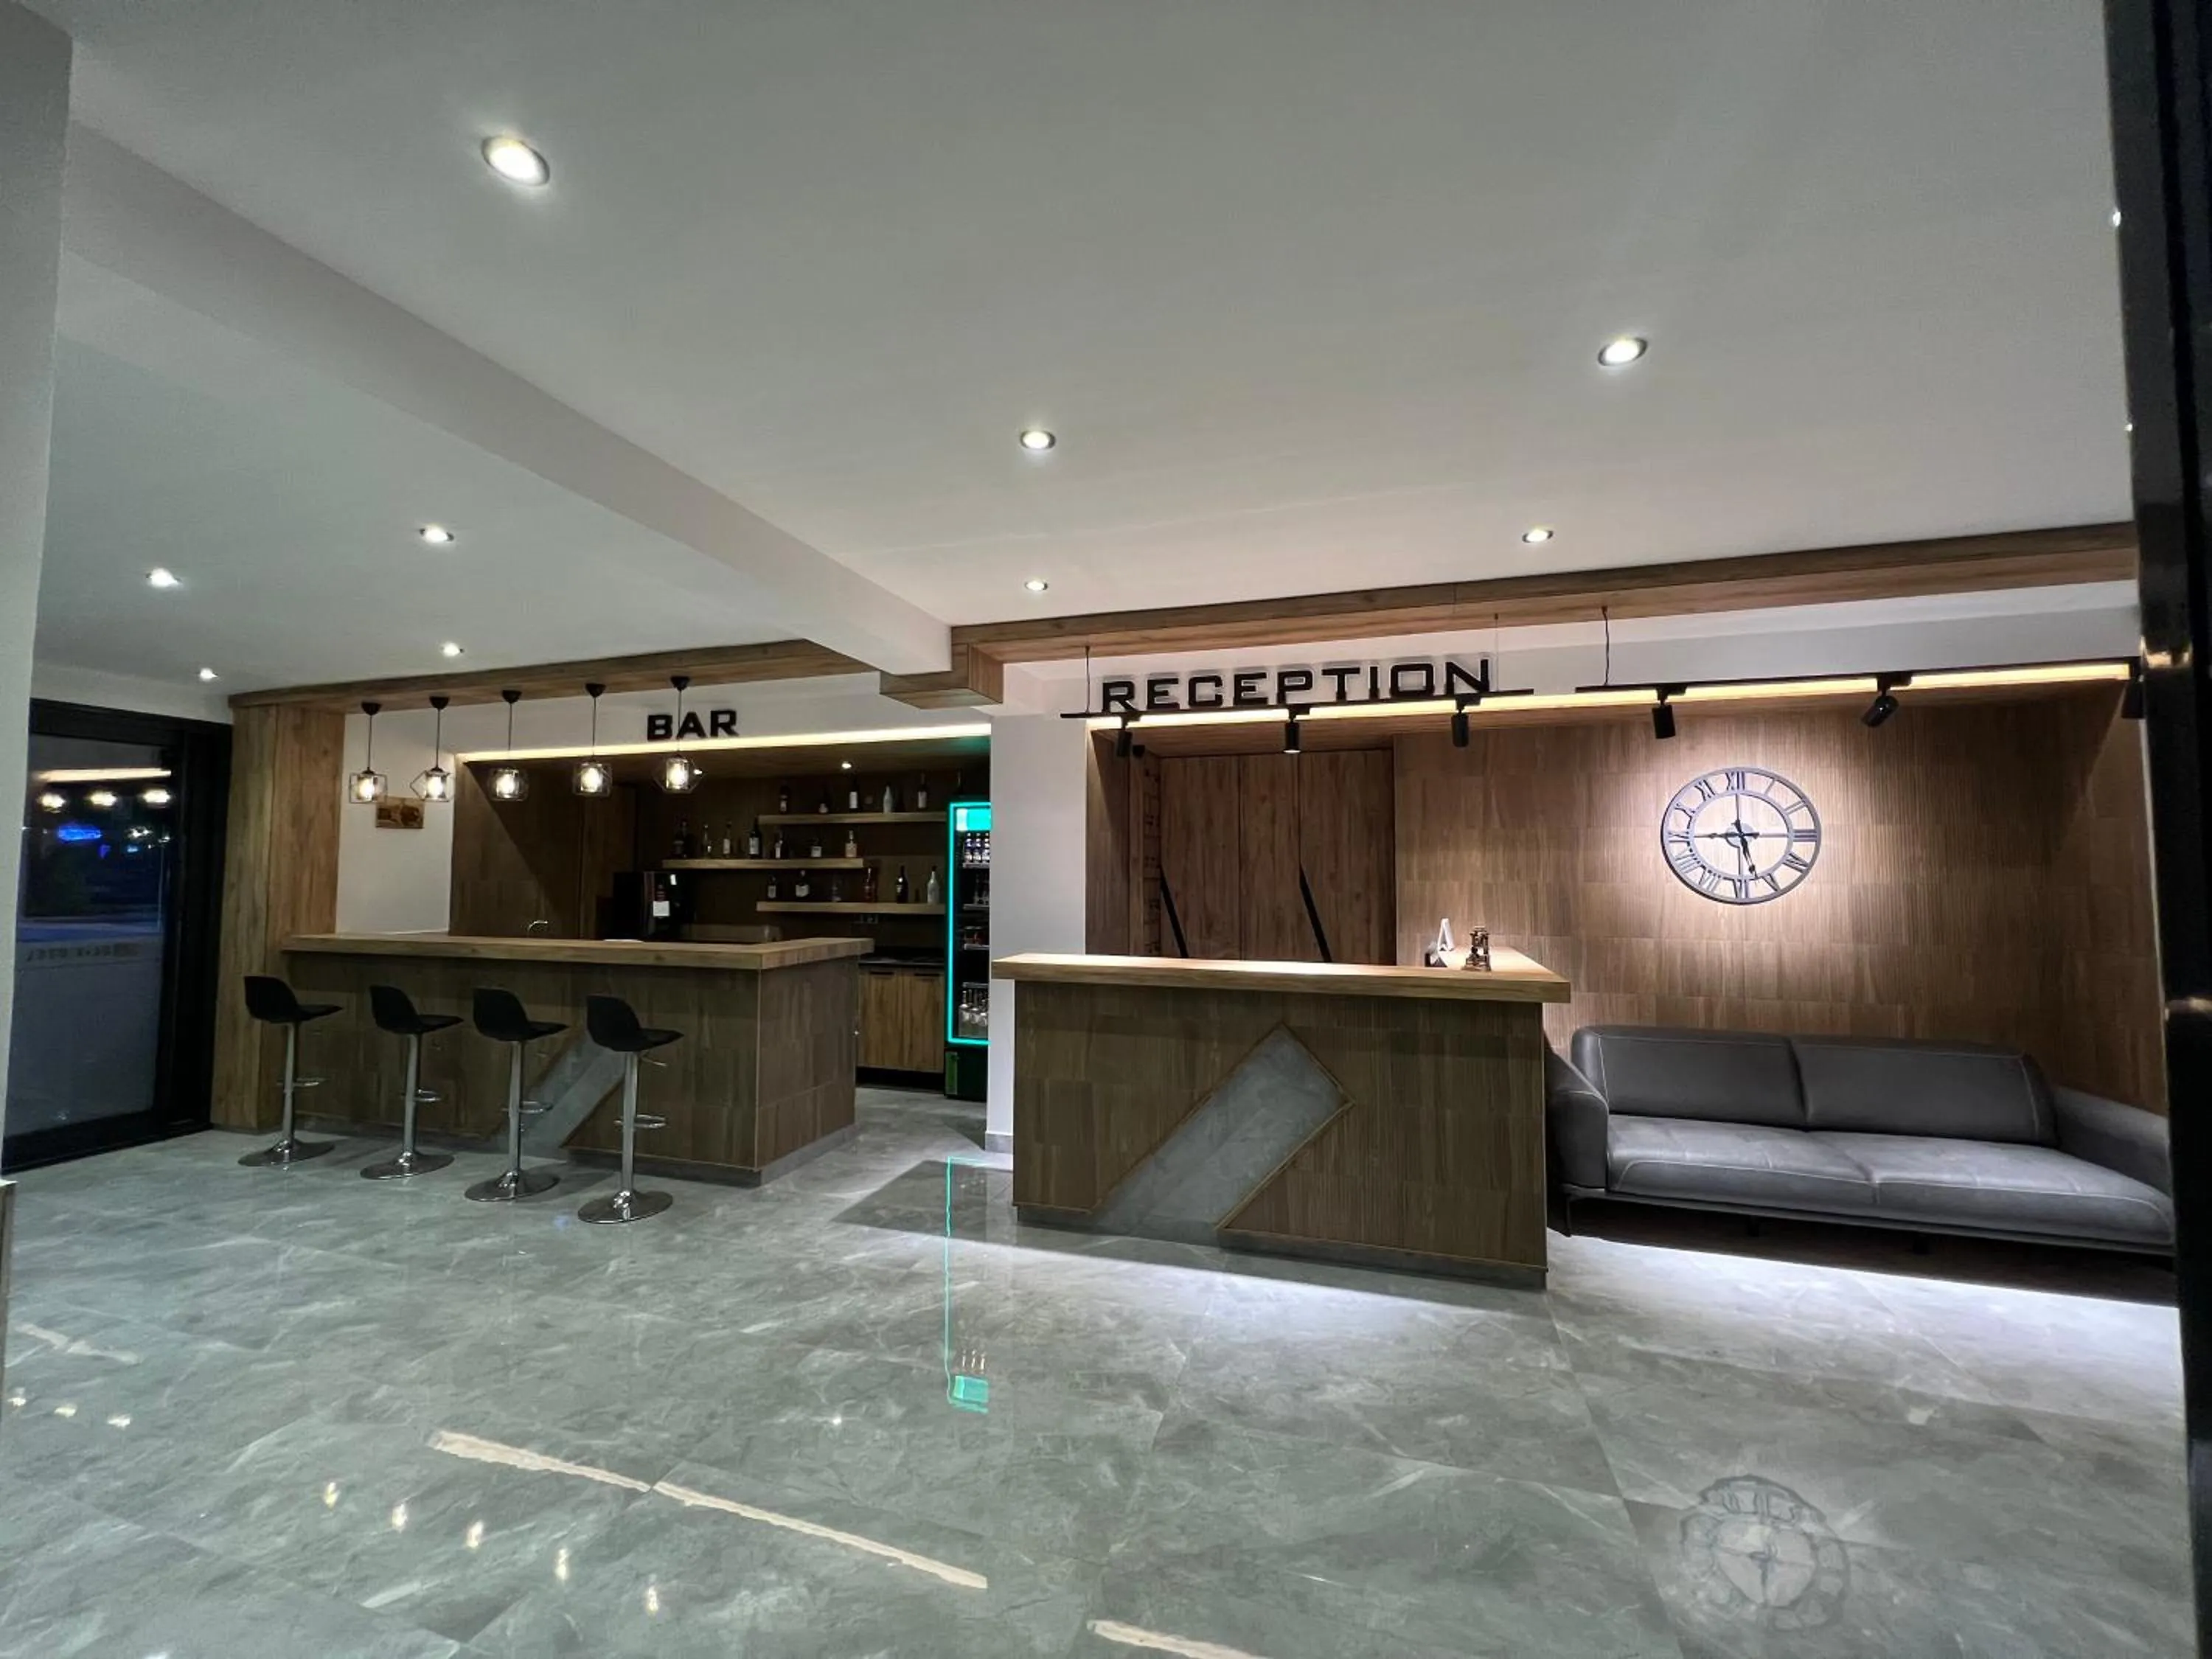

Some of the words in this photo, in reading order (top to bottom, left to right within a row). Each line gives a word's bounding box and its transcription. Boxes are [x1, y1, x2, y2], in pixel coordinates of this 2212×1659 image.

[1102, 659, 1489, 712] RECEPTION
[647, 710, 739, 740] BAR
[1725, 771, 1745, 791] XII
